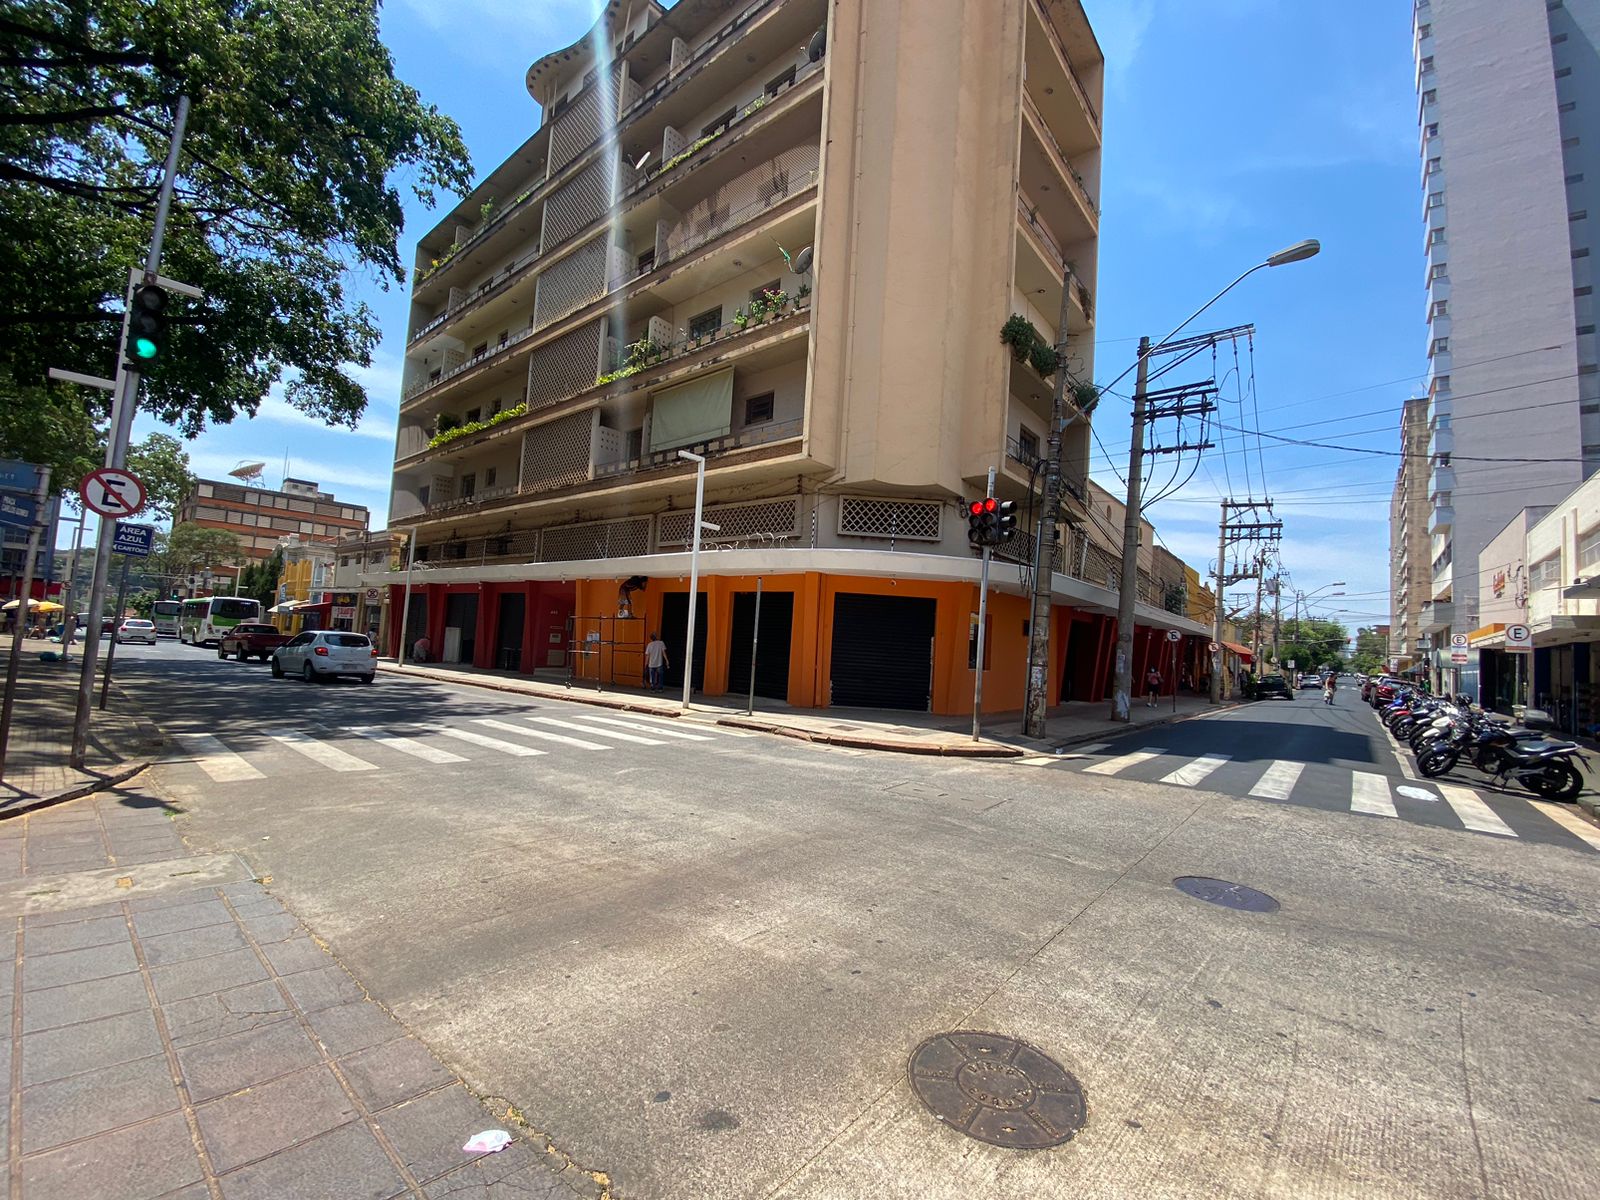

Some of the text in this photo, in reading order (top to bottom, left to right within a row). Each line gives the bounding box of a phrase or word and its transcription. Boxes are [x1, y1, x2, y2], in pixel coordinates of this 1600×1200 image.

[101, 479, 126, 508] E
[119, 534, 145, 544] AZUL
[1514, 628, 1522, 639] E
